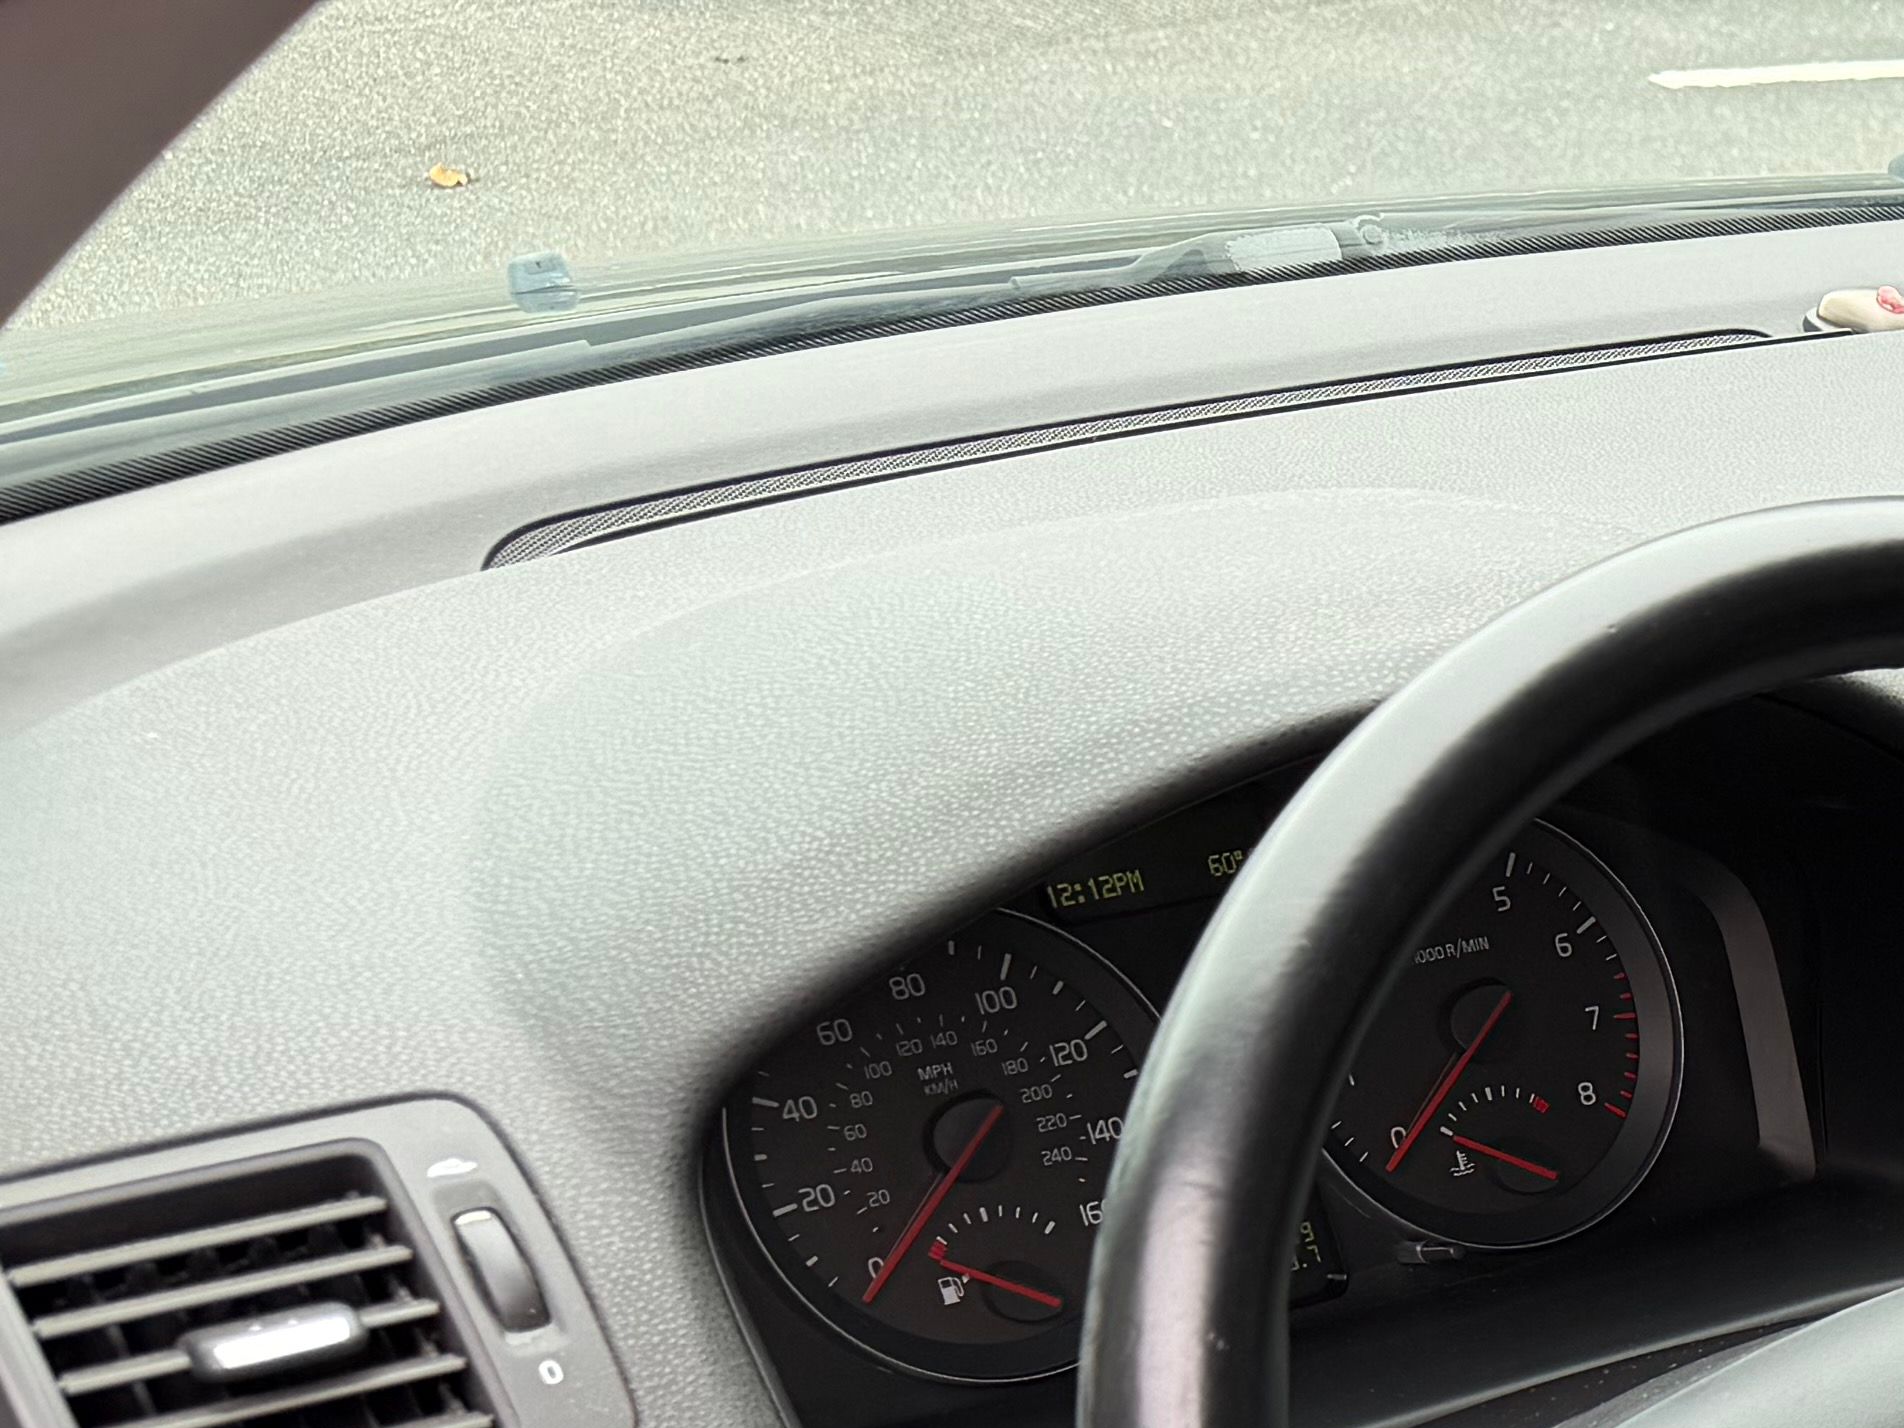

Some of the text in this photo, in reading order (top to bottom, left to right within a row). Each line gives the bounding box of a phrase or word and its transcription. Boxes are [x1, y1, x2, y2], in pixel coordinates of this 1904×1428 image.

[1047, 869, 1145, 908] 12:12PM
[1492, 886, 1511, 912] 5
[1445, 936, 1489, 959] R/MIN
[1554, 932, 1573, 957] 6
[889, 973, 926, 1000] 80
[975, 986, 1018, 1015] 100
[1584, 1005, 1599, 1031] 7
[816, 1018, 853, 1046] 60
[930, 1031, 958, 1049] 140
[896, 1039, 923, 1057] 120
[971, 1038, 998, 1057] 160
[1049, 1039, 1088, 1067] 120
[864, 1060, 893, 1080] 100
[917, 1061, 953, 1081] MPH
[1002, 1057, 1029, 1076] 180
[924, 1078, 959, 1096] KM/H
[1020, 1084, 1053, 1104] 200
[1578, 1082, 1597, 1106] 8
[782, 1096, 818, 1122] 40
[850, 1091, 873, 1109] 80
[844, 1123, 868, 1141] 60
[1036, 1113, 1067, 1133] 220
[1087, 1117, 1124, 1145] 140
[850, 1157, 873, 1174] 40
[1041, 1146, 1072, 1166] 240
[798, 1184, 836, 1212] 20
[866, 1189, 890, 1208] 20
[1079, 1201, 1104, 1227] 16
